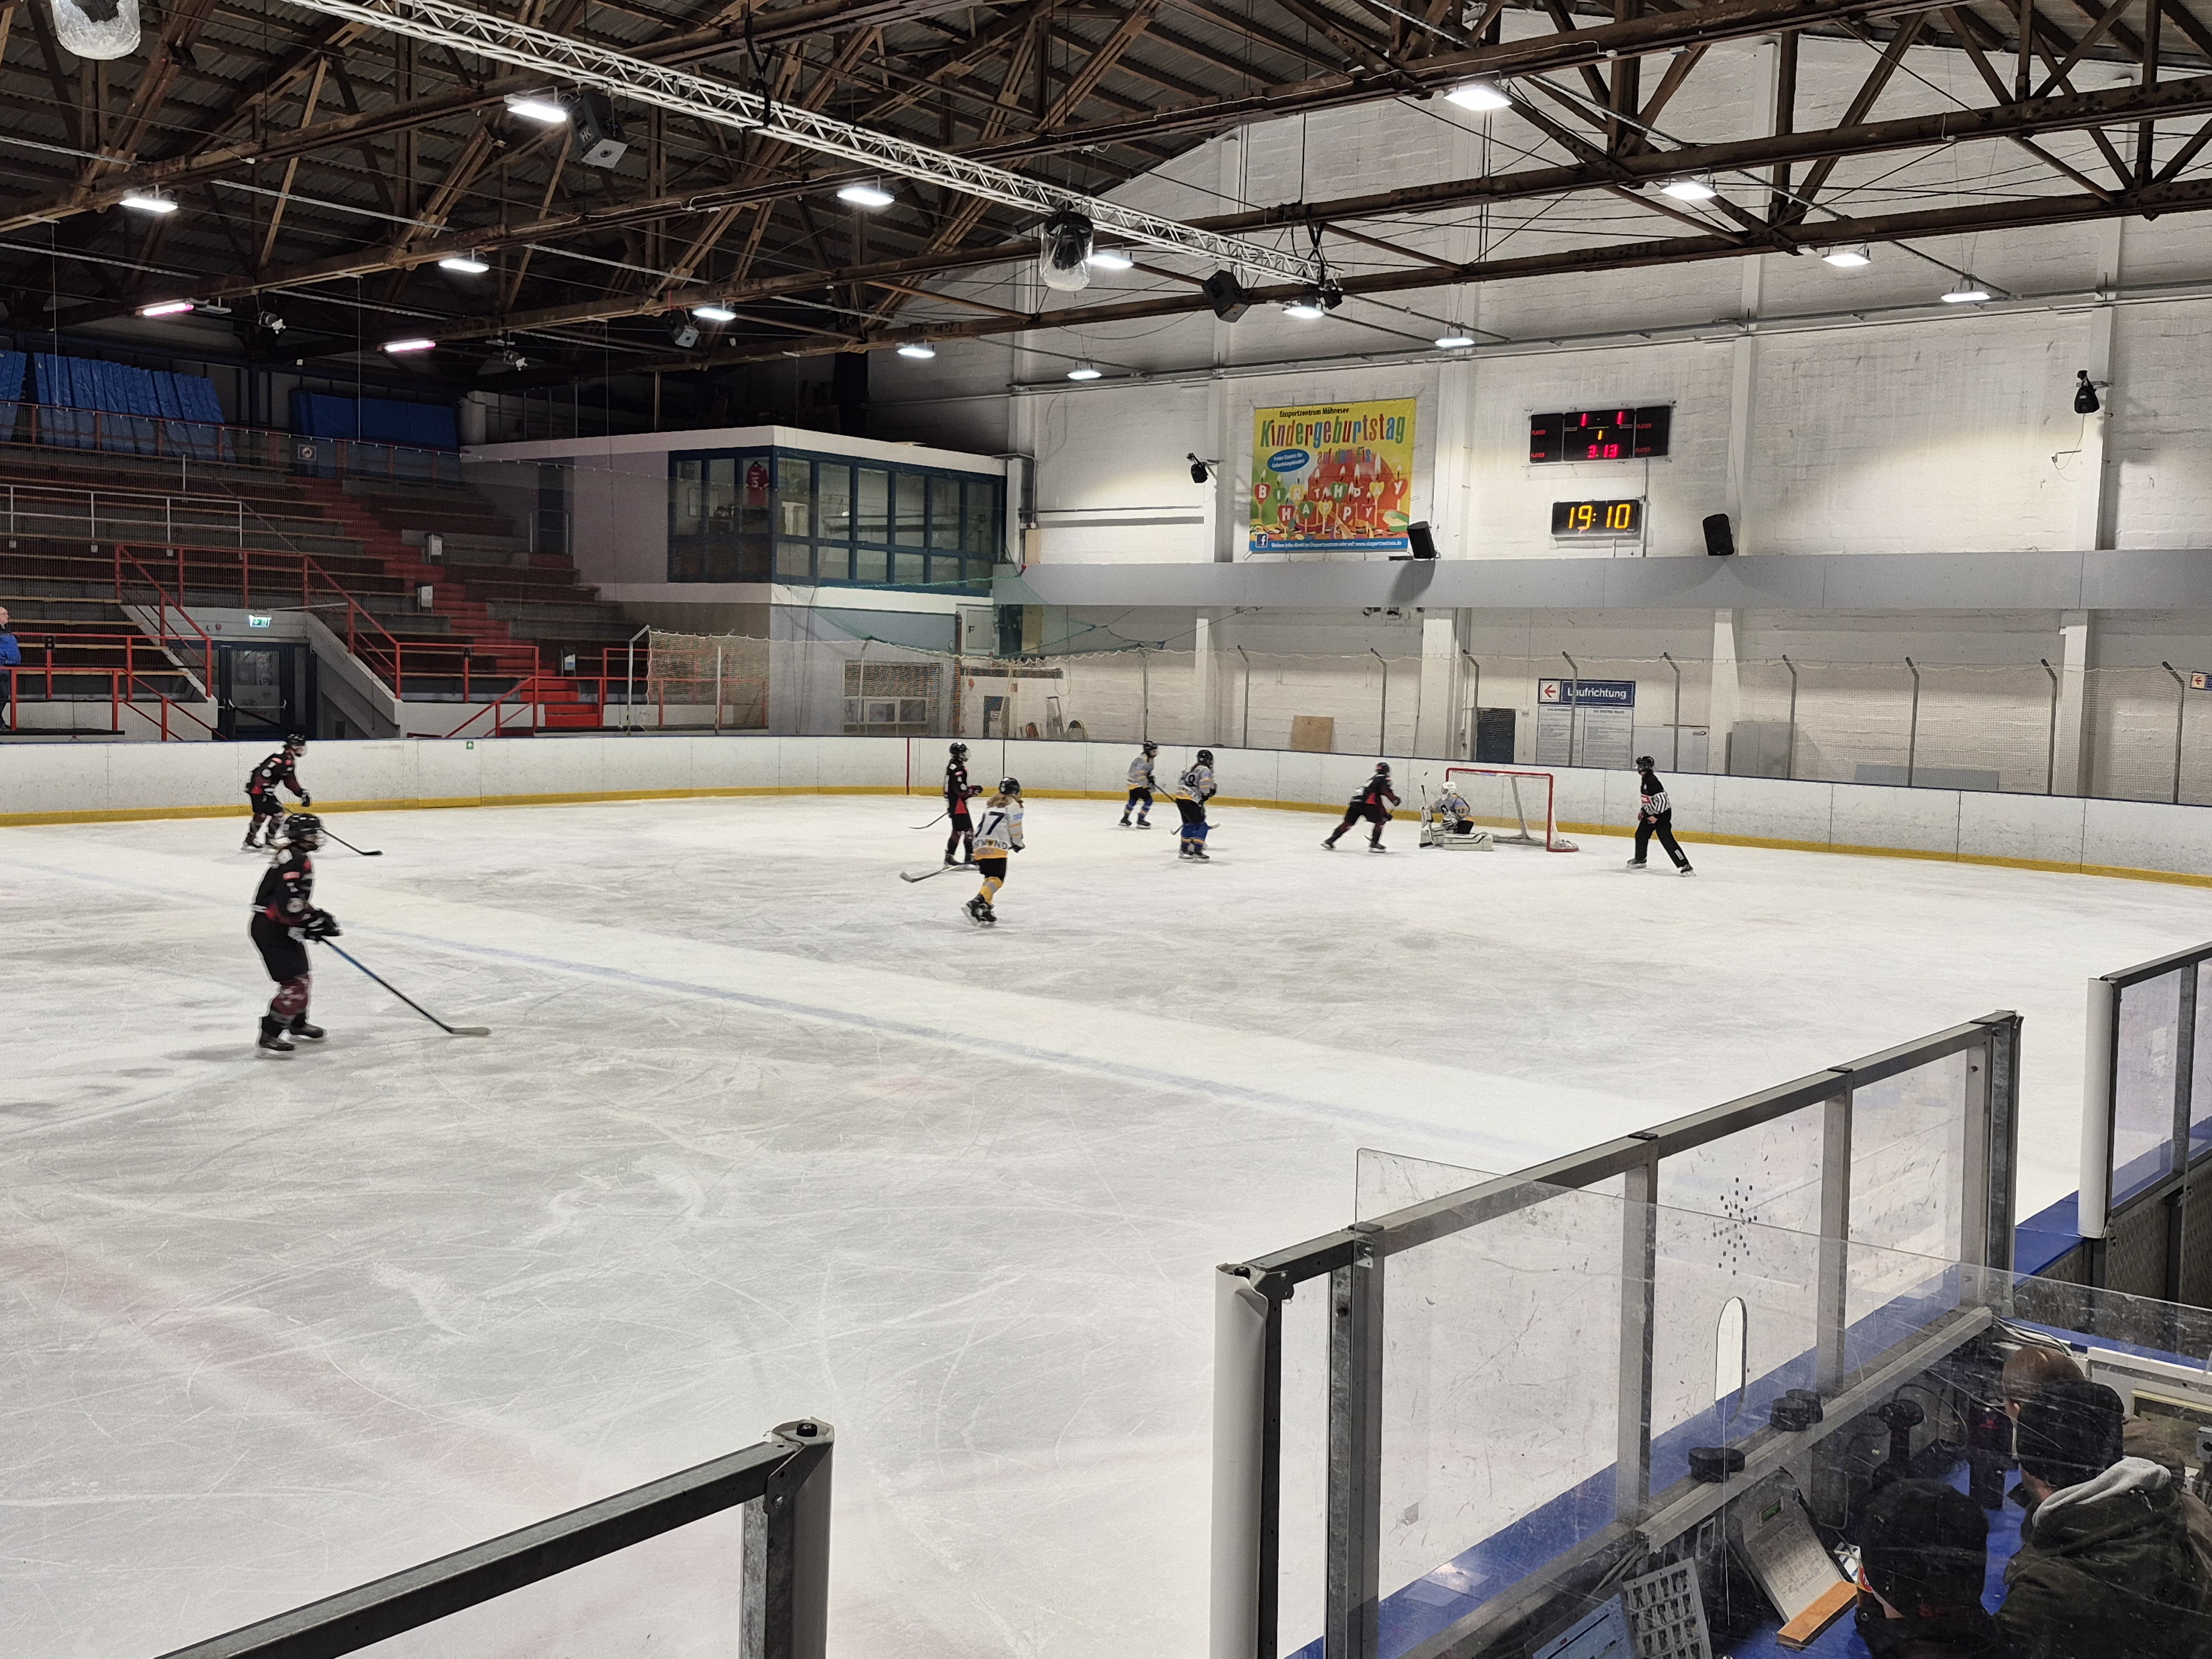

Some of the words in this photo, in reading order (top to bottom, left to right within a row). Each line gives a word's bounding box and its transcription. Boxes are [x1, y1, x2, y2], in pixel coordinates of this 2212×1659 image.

[1582, 413, 1587, 426] 1
[1617, 411, 1623, 425] 1
[1260, 414, 1406, 448] Kindergeburtstag
[1598, 430, 1603, 440] 1
[1568, 503, 1631, 530] 19:10
